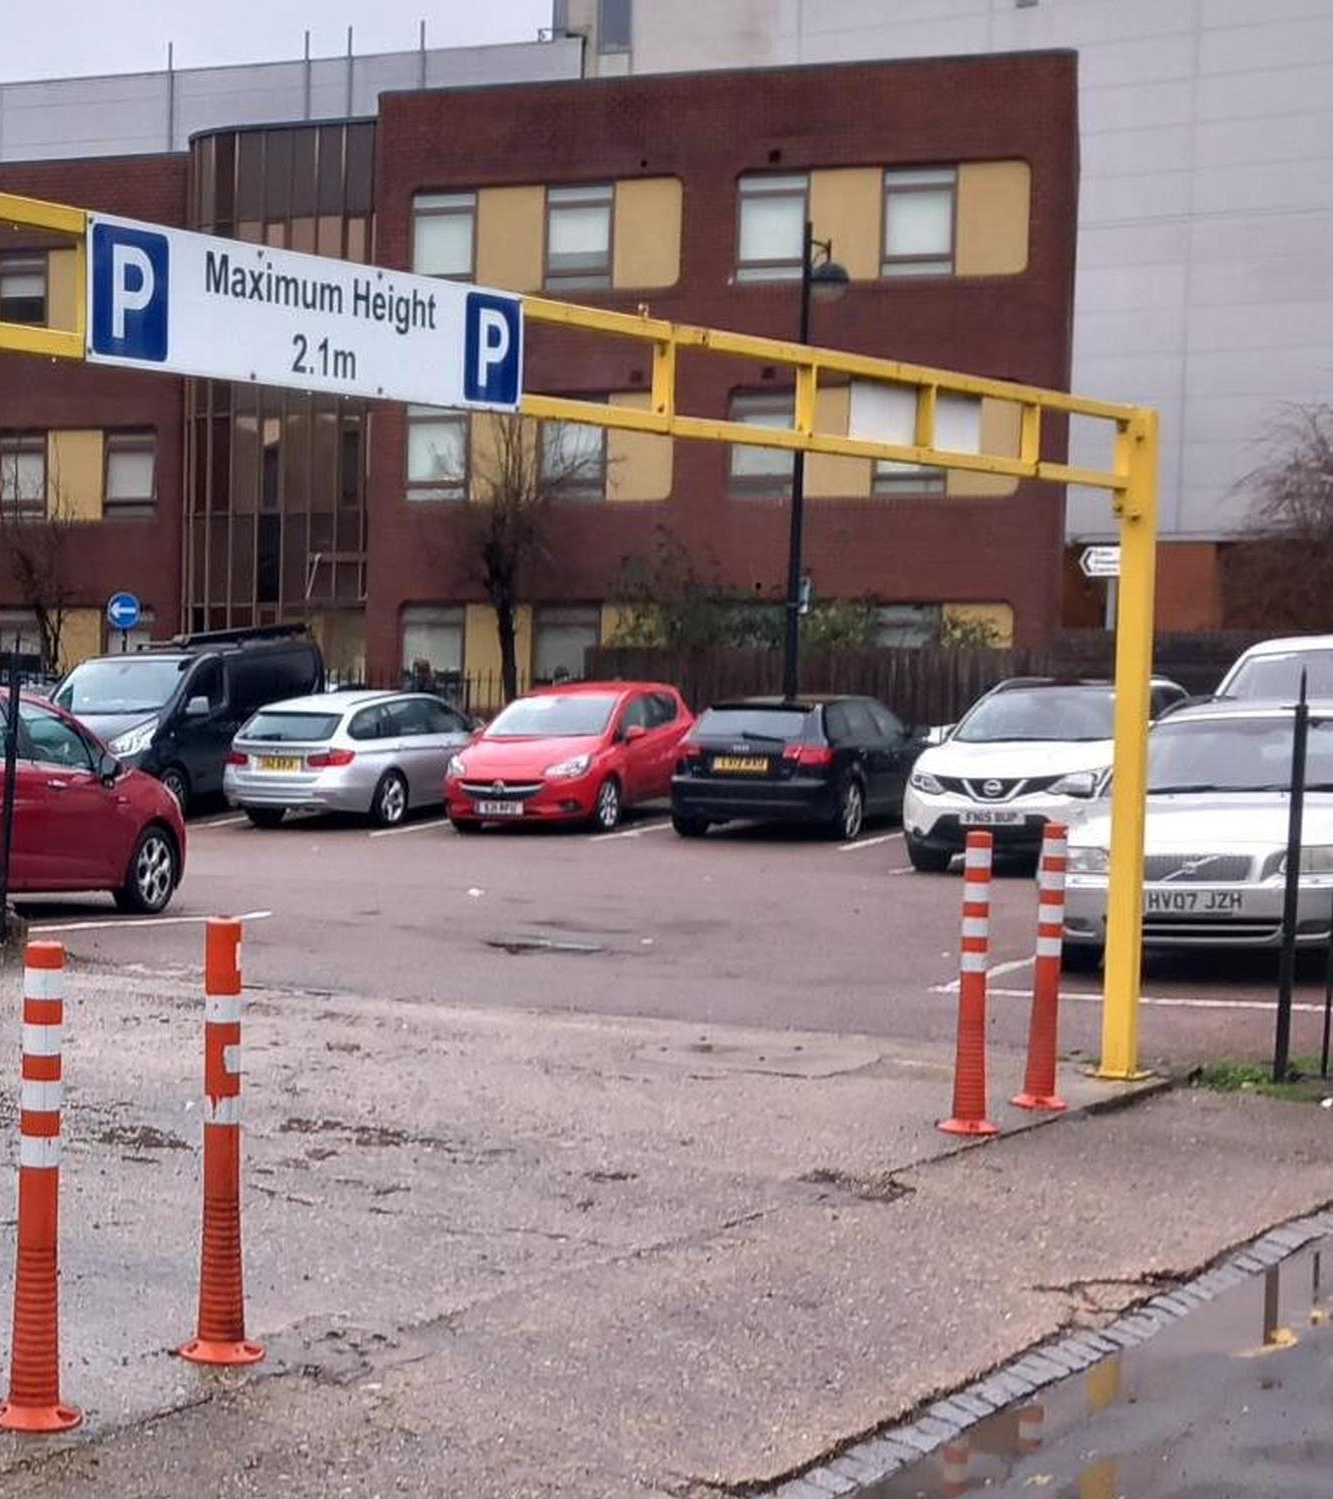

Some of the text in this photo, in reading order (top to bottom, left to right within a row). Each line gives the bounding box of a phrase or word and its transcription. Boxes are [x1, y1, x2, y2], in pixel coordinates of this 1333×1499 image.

[112, 243, 155, 339] P
[206, 251, 436, 335] Maximum Height
[292, 334, 356, 380] 2.1m
[478, 308, 509, 387] P
[1148, 892, 1242, 910] HV07 JZH
